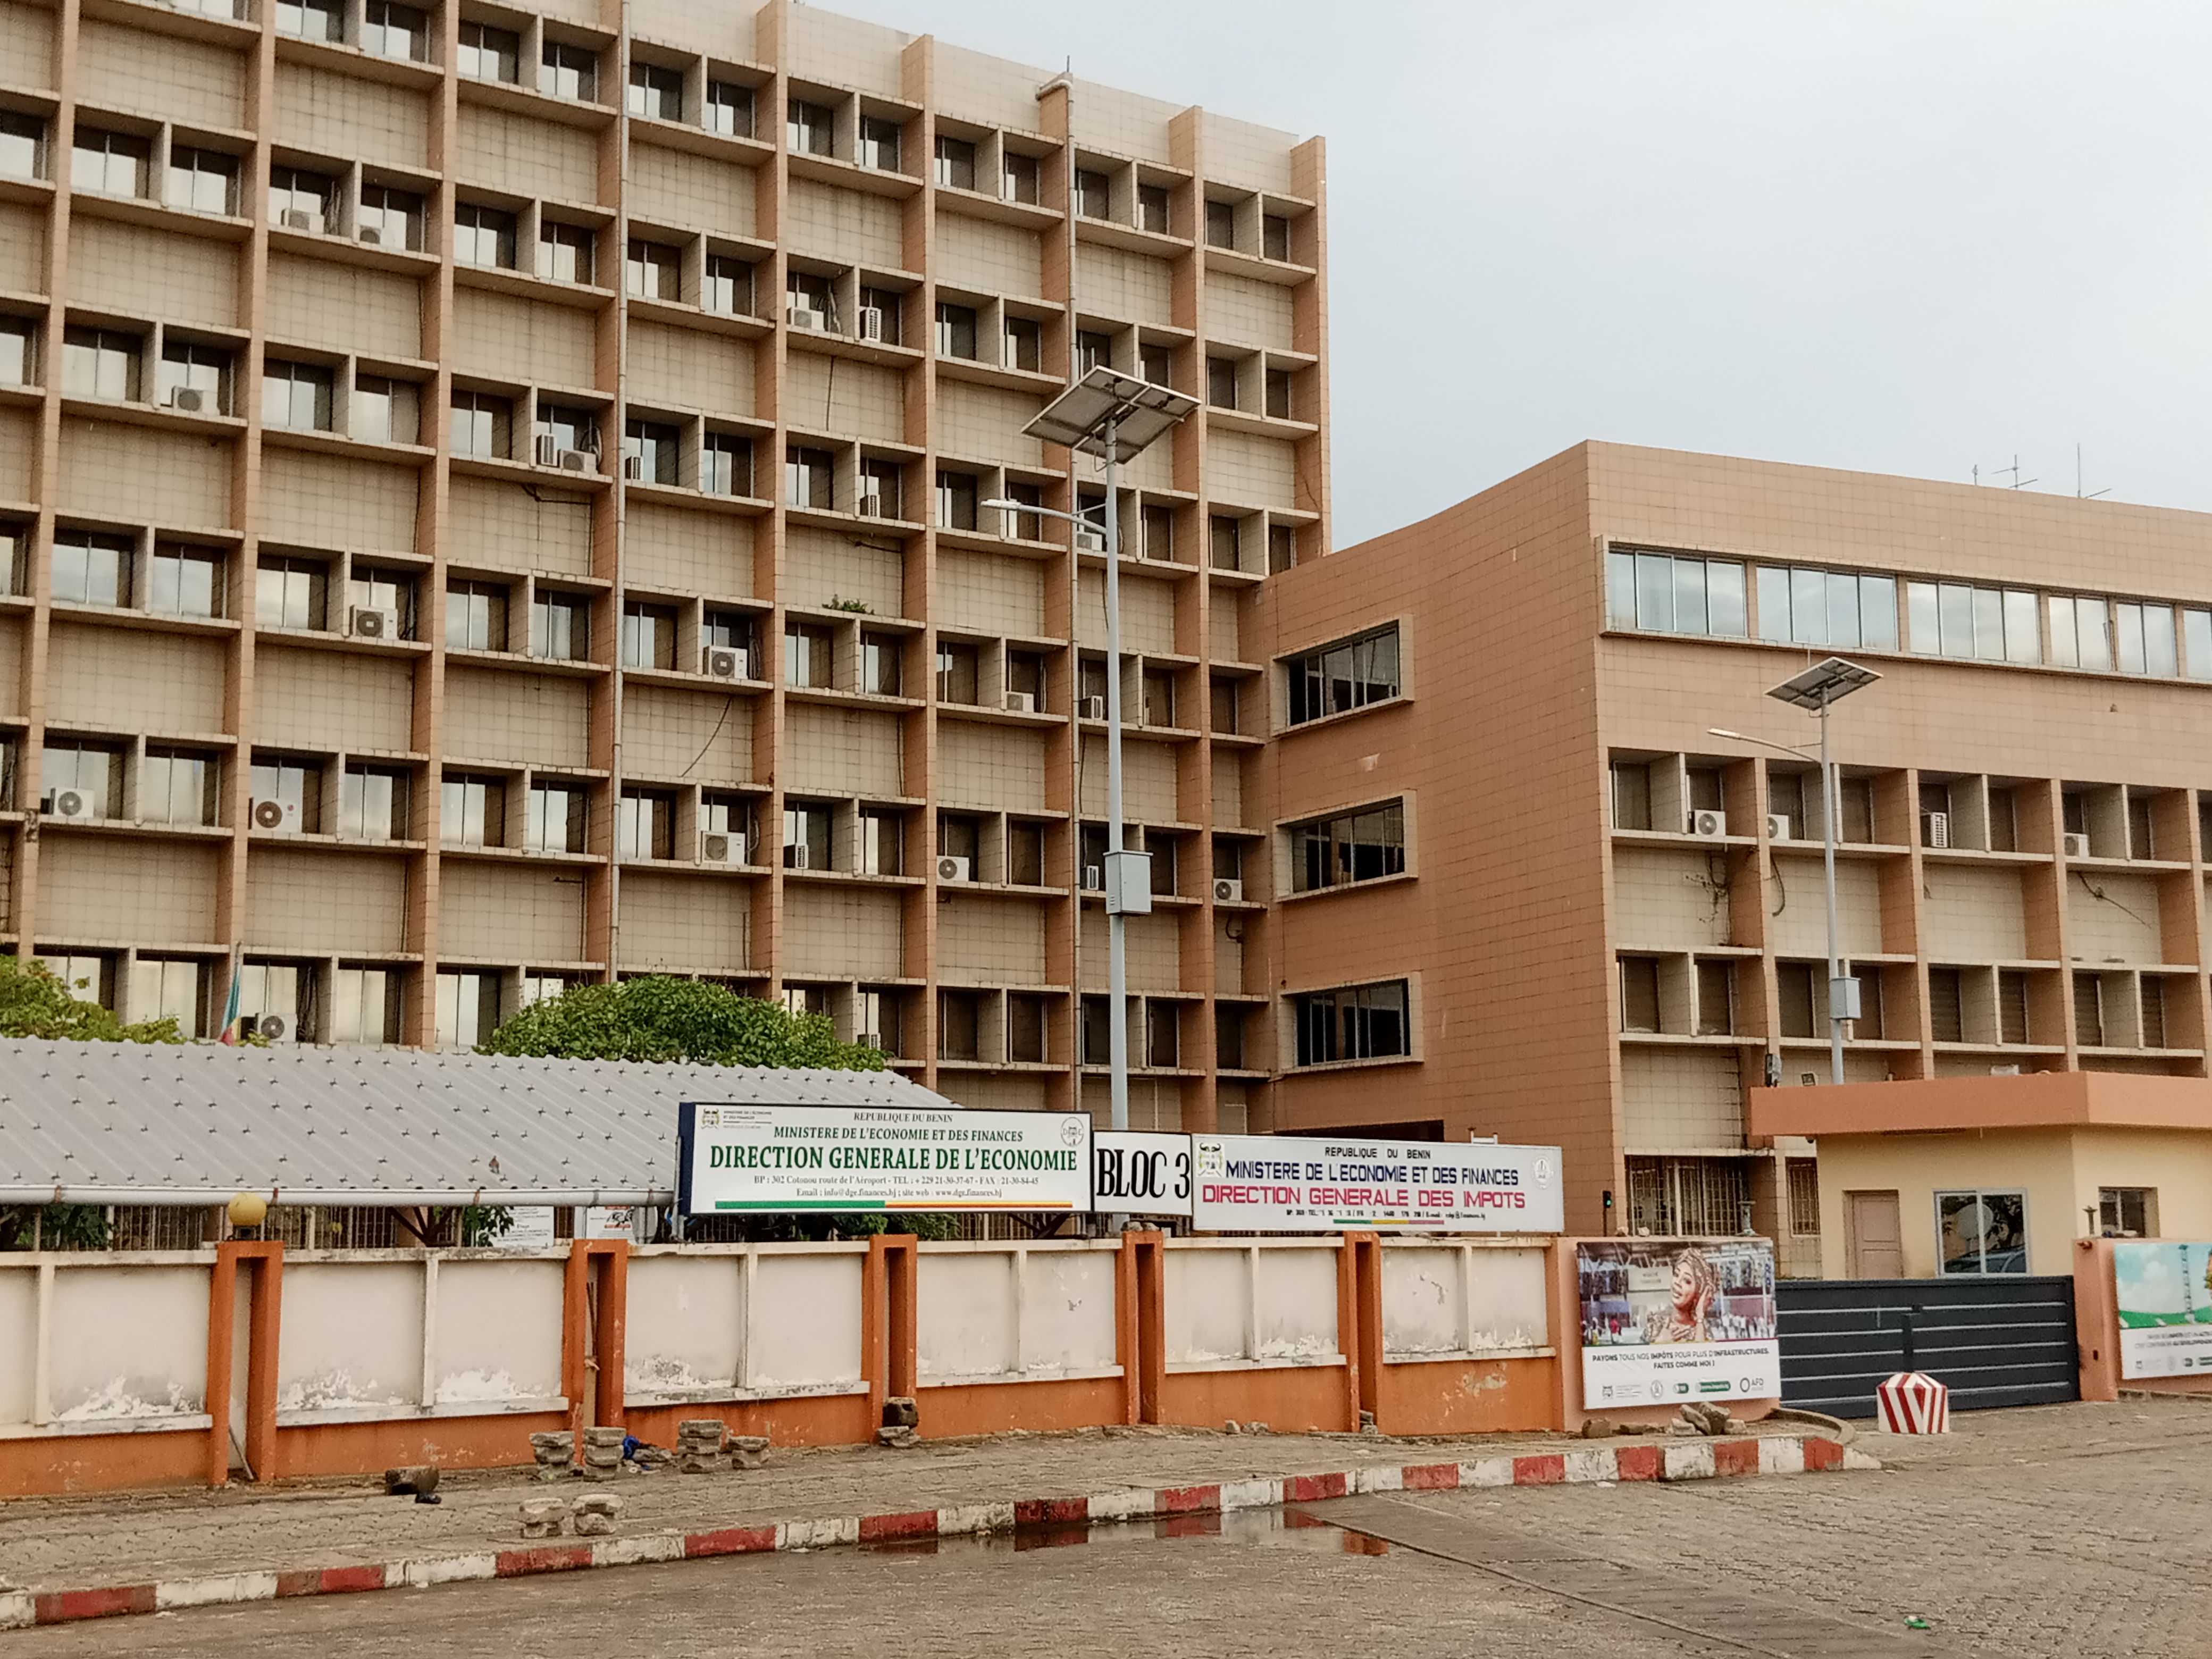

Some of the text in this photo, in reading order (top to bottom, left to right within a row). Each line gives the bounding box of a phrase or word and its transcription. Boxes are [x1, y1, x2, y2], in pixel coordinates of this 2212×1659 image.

[854, 1112, 953, 1123] REPUBLIQUE DU BENIN
[774, 1126, 1023, 1142] MINISTERE DE L'ECONOMIE ET DES FINANCES
[710, 1145, 1077, 1170] DIRECTION GENERALE DE L'ECONOMIE
[1325, 1147, 1431, 1159] REPUBLIQUE DU BENIN
[849, 1176, 886, 1186] l'Aéroport
[1096, 1149, 1190, 1199] BLOC 3
[1226, 1160, 1518, 1185] MINISTERE DE L'ECONOMIE ET DES FINANCES
[1203, 1185, 1526, 1209] DIRECTION GENERALE DES IMPOTS
